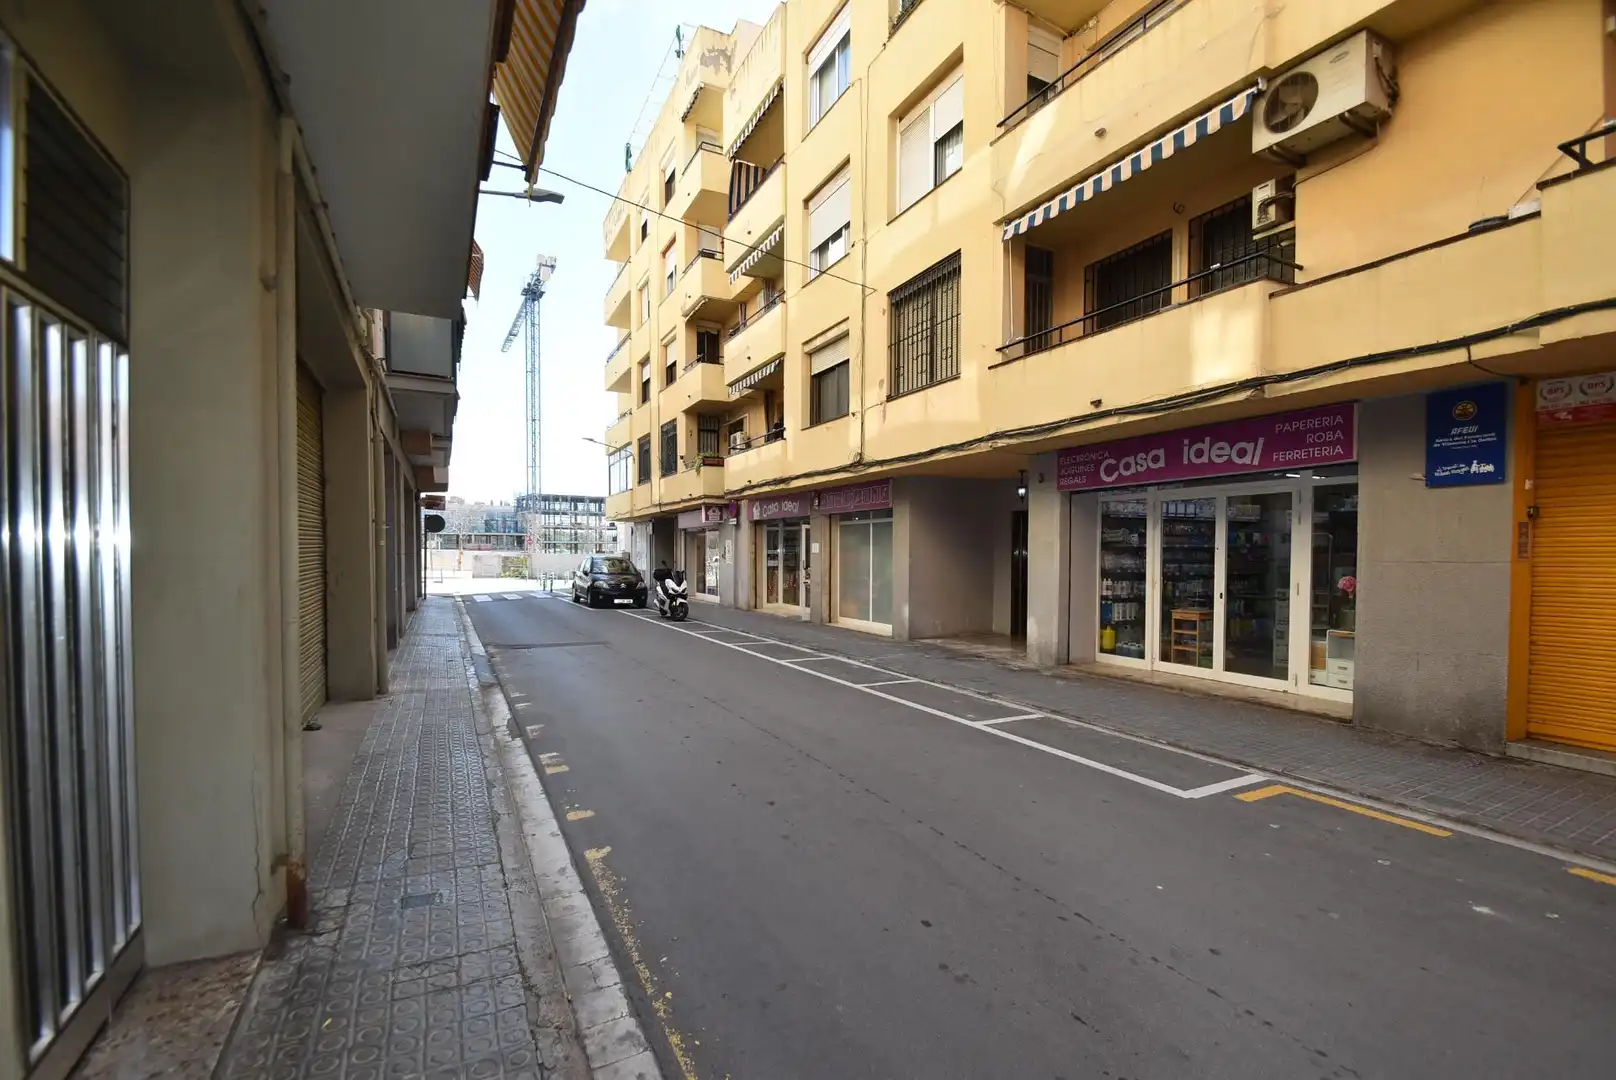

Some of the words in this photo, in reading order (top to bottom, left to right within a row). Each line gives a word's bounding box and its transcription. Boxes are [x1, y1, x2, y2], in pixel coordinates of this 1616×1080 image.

[1275, 415, 1344, 434] PAPERERIA
[1306, 429, 1344, 444] ROBA
[1100, 448, 1166, 482] Casa
[1183, 436, 1265, 466] ideal
[1272, 444, 1344, 462] FERRETERIA
[1059, 463, 1095, 476] JOGUINES
[1059, 475, 1087, 486] REGALS
